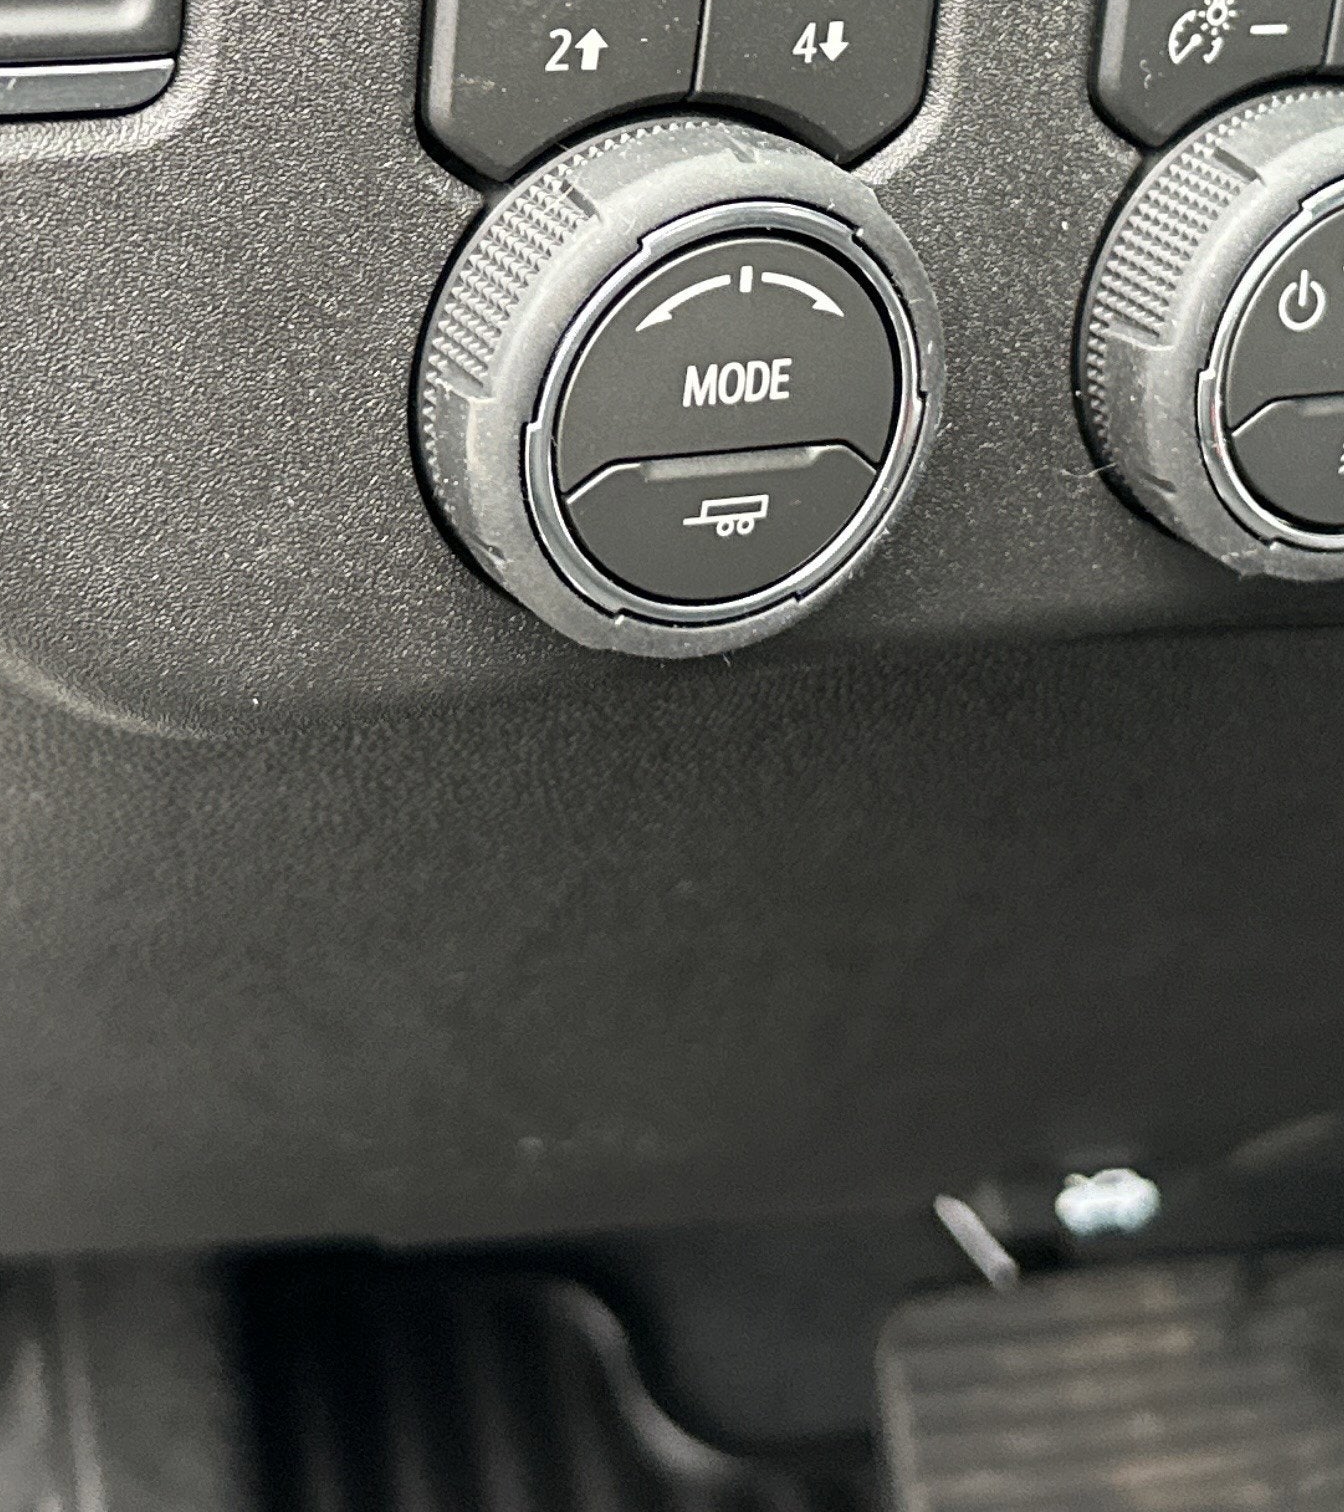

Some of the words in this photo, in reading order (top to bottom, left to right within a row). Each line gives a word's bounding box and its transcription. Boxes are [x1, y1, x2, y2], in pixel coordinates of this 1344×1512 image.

[544, 27, 572, 72] 2
[792, 21, 818, 65] 4
[681, 356, 793, 408] MODE
